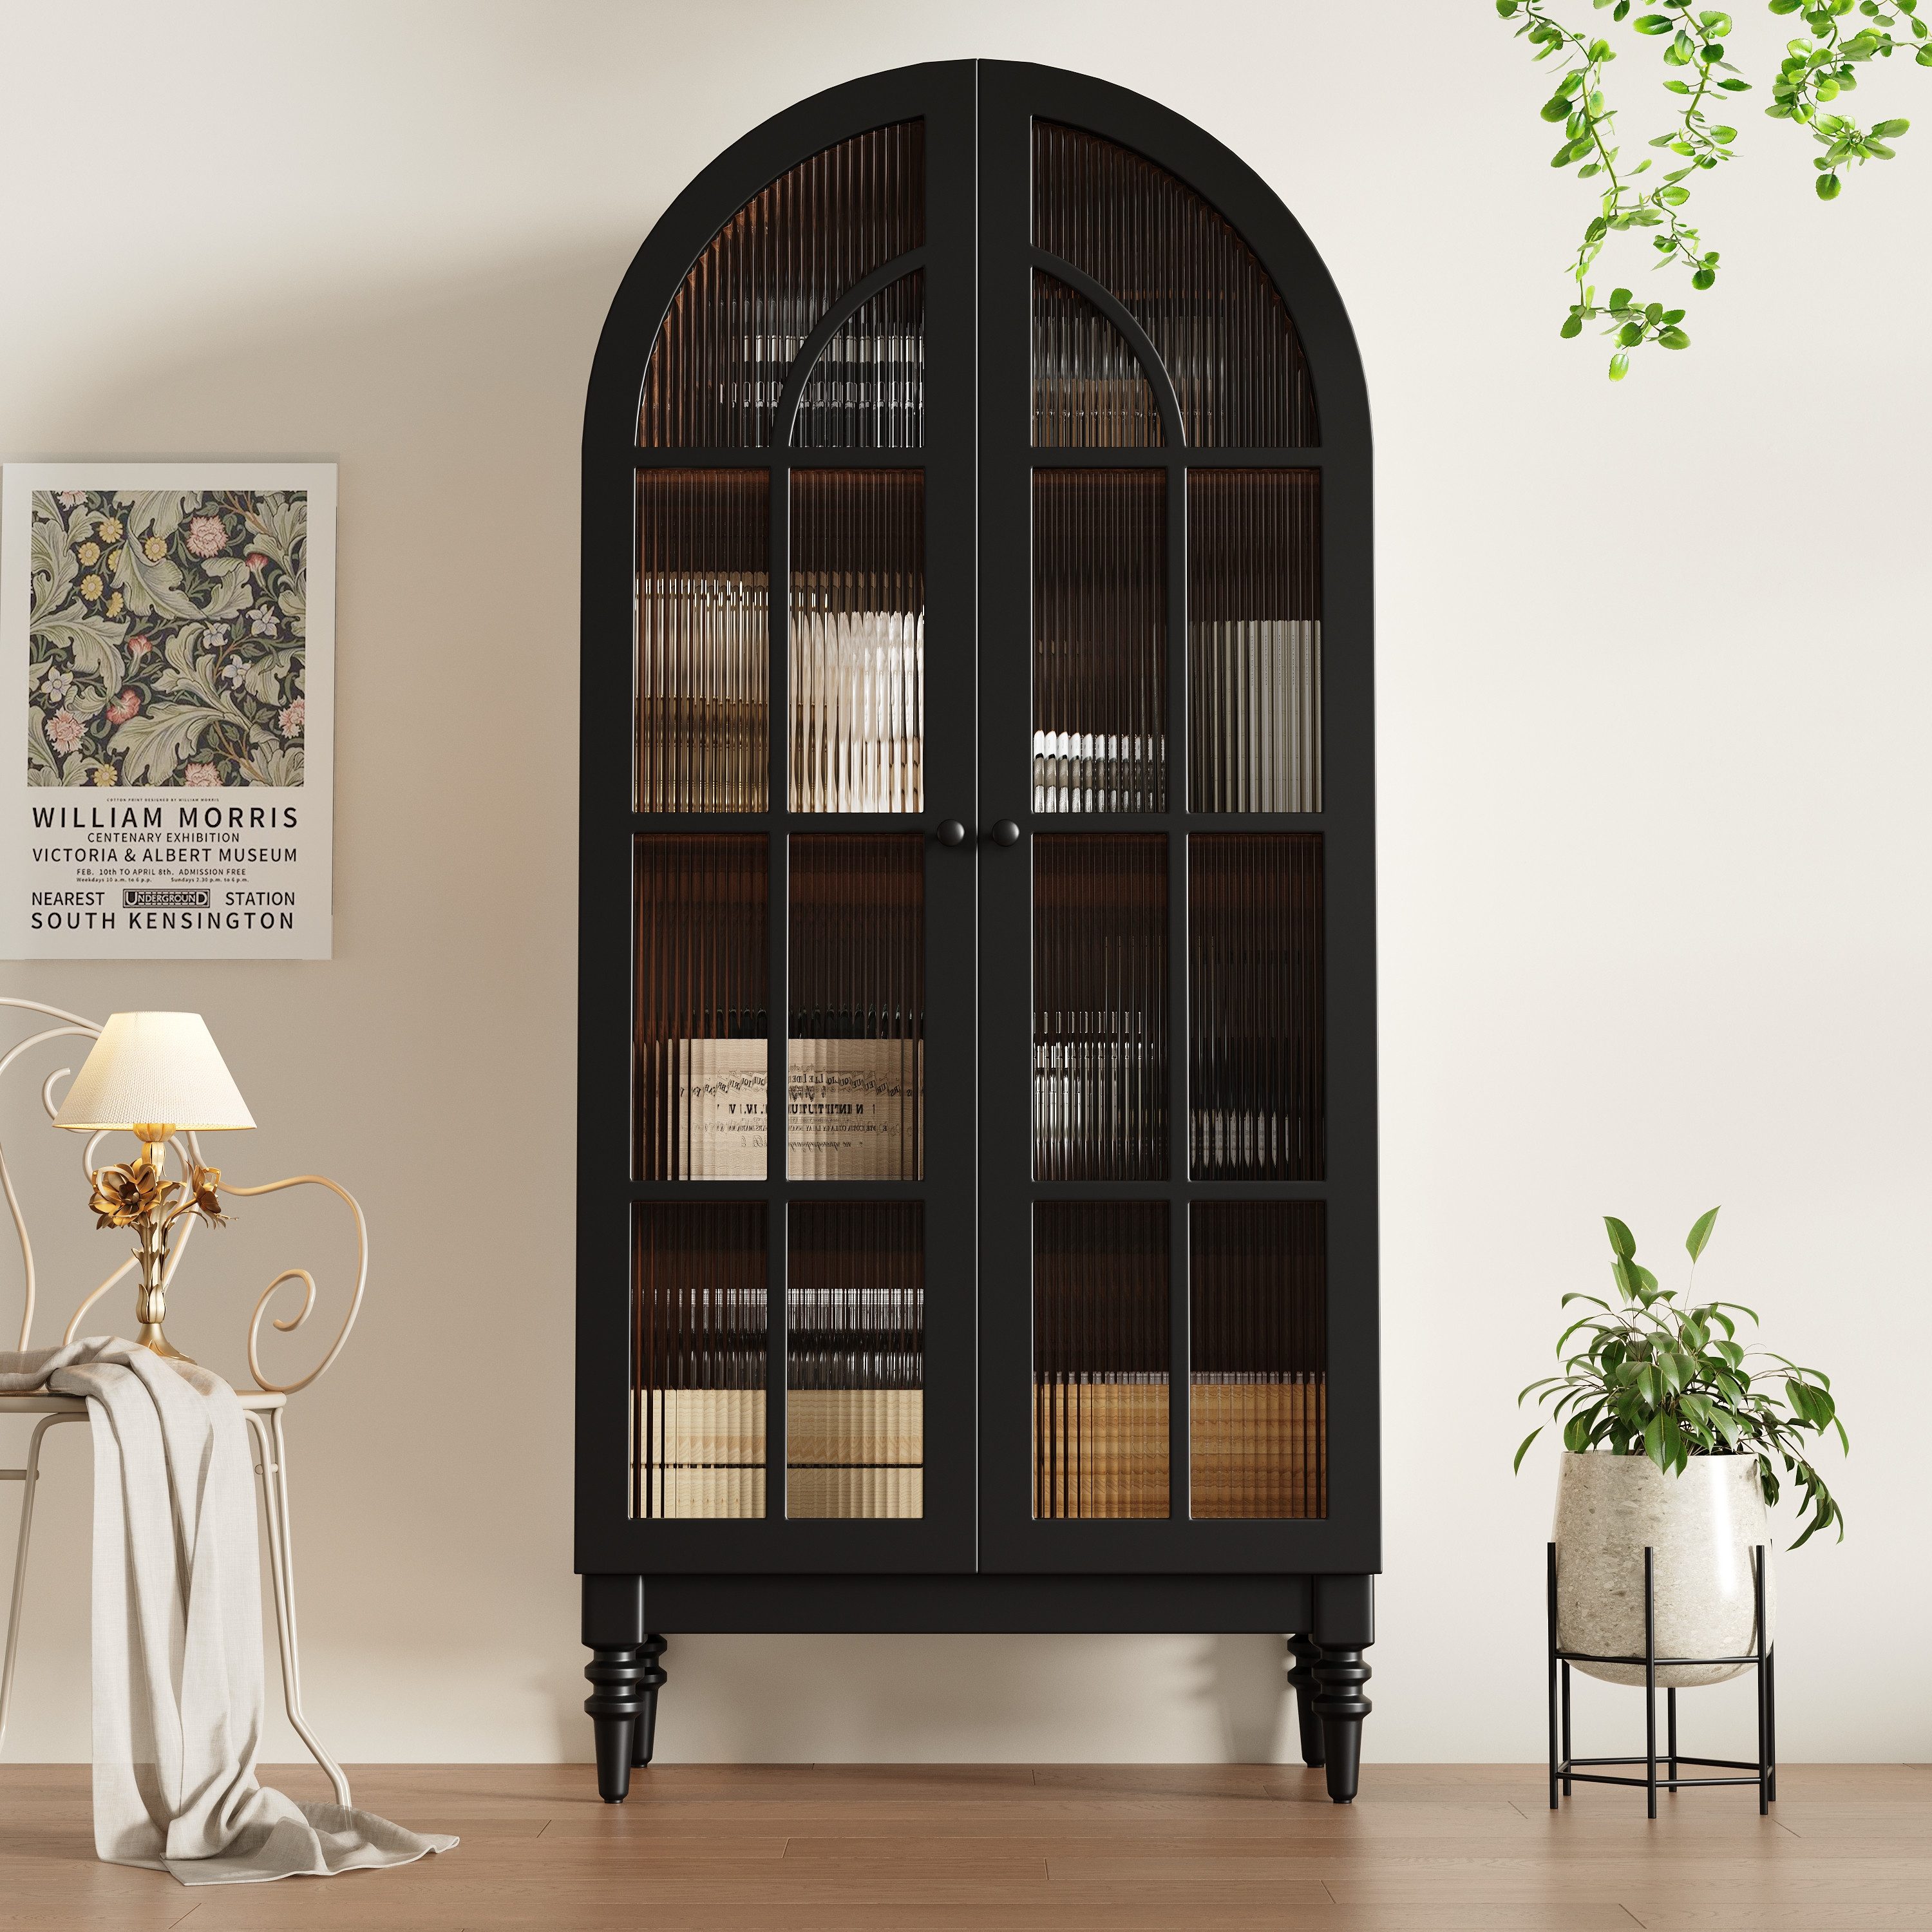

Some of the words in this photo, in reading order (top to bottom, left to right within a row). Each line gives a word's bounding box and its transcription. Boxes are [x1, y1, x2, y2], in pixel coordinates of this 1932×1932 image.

[32, 808, 161, 828] WILLIAM
[180, 807, 297, 828] MORRIS
[88, 833, 161, 842] CENTENARY
[167, 833, 239, 842] EXHIBITION
[32, 848, 118, 862] VICTORIA
[124, 848, 136, 862] &
[142, 848, 212, 862] ALBERT
[220, 848, 296, 862] MUSEUM
[32, 892, 105, 905] NEAREST
[125, 891, 208, 906] UNDERGROUND
[225, 892, 294, 905] STATION
[32, 912, 115, 929] SOUTH
[129, 913, 292, 929] KENSINGTON
